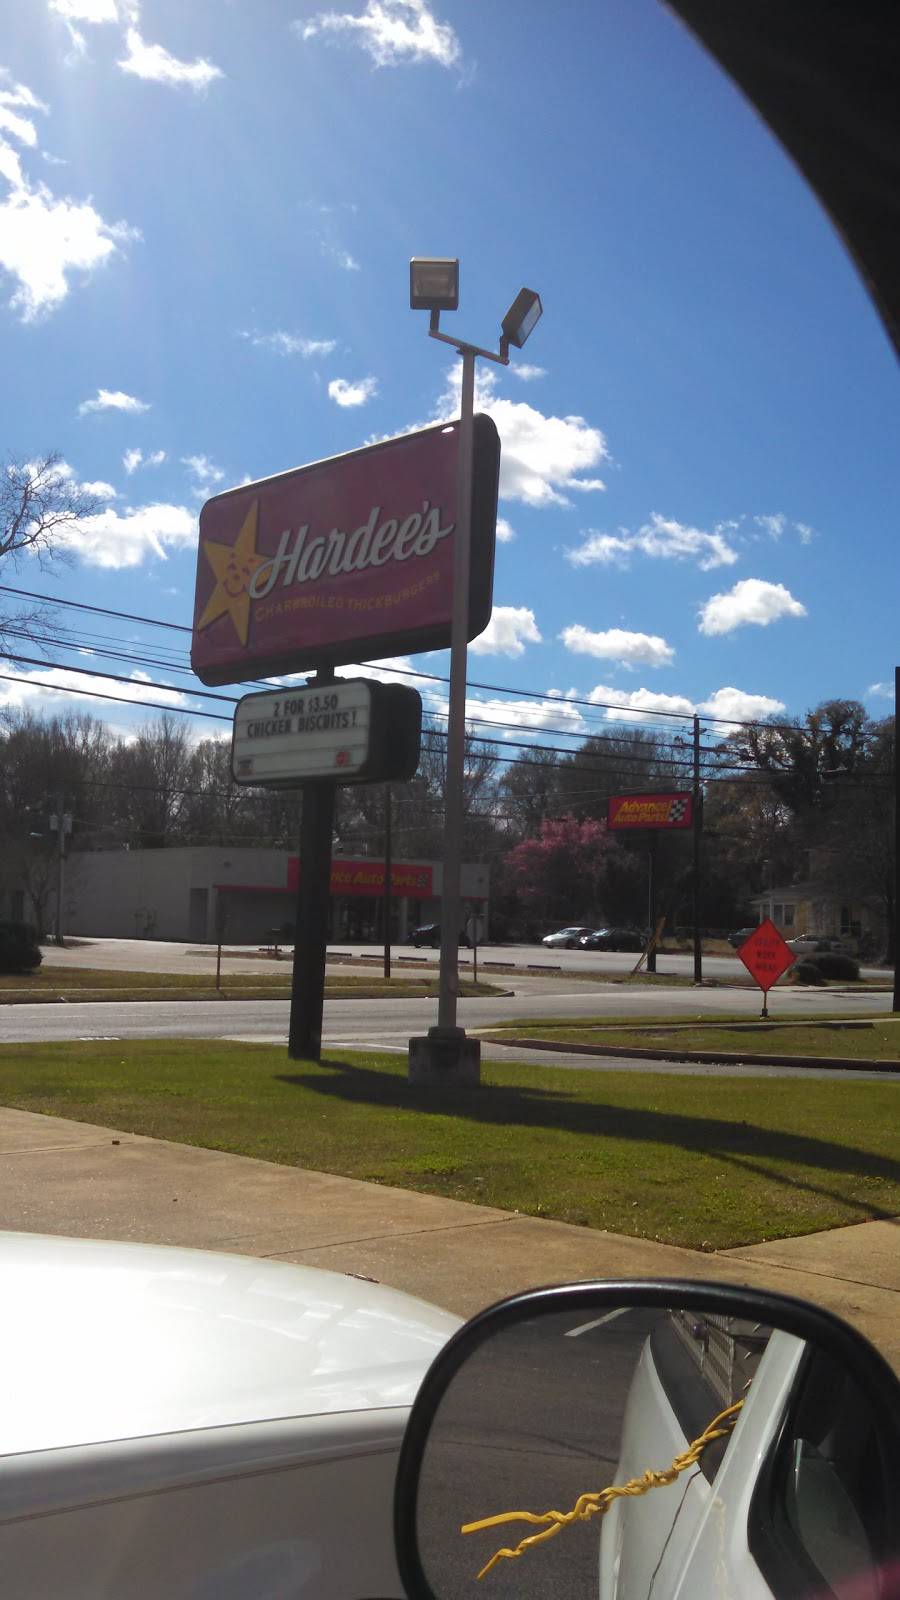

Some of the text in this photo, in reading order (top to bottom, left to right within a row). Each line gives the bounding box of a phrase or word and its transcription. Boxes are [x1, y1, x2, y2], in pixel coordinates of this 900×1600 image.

[249, 501, 454, 599] Hardee's
[255, 569, 441, 623] CHARBROILED THICKBURGERS
[273, 694, 338, 717] 2 FOR $3.50
[247, 719, 292, 738] CHICKEN
[619, 800, 669, 813] Advance
[613, 812, 638, 824] Auto
[352, 870, 385, 885] Auto
